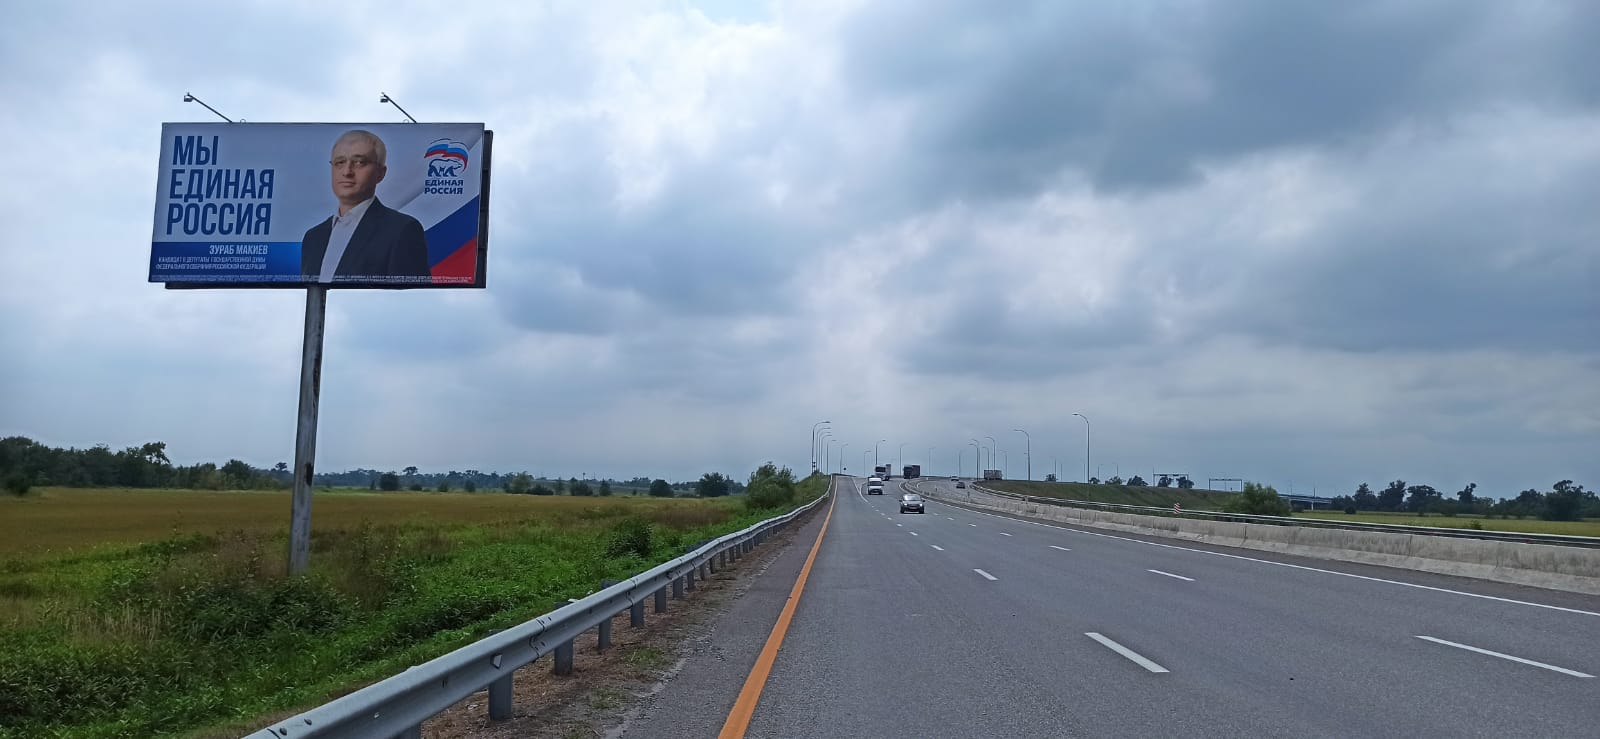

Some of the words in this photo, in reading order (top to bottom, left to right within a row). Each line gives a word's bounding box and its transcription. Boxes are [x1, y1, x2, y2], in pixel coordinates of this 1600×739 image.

[172, 135, 219, 165] МЫ
[169, 168, 275, 203] ЕДИНАЯ
[424, 179, 464, 187] ЕДИНАЯ
[166, 202, 272, 235] РОССИЯ
[209, 244, 235, 255] ЗУРАБ
[236, 244, 268, 255] МАКИЕВ
